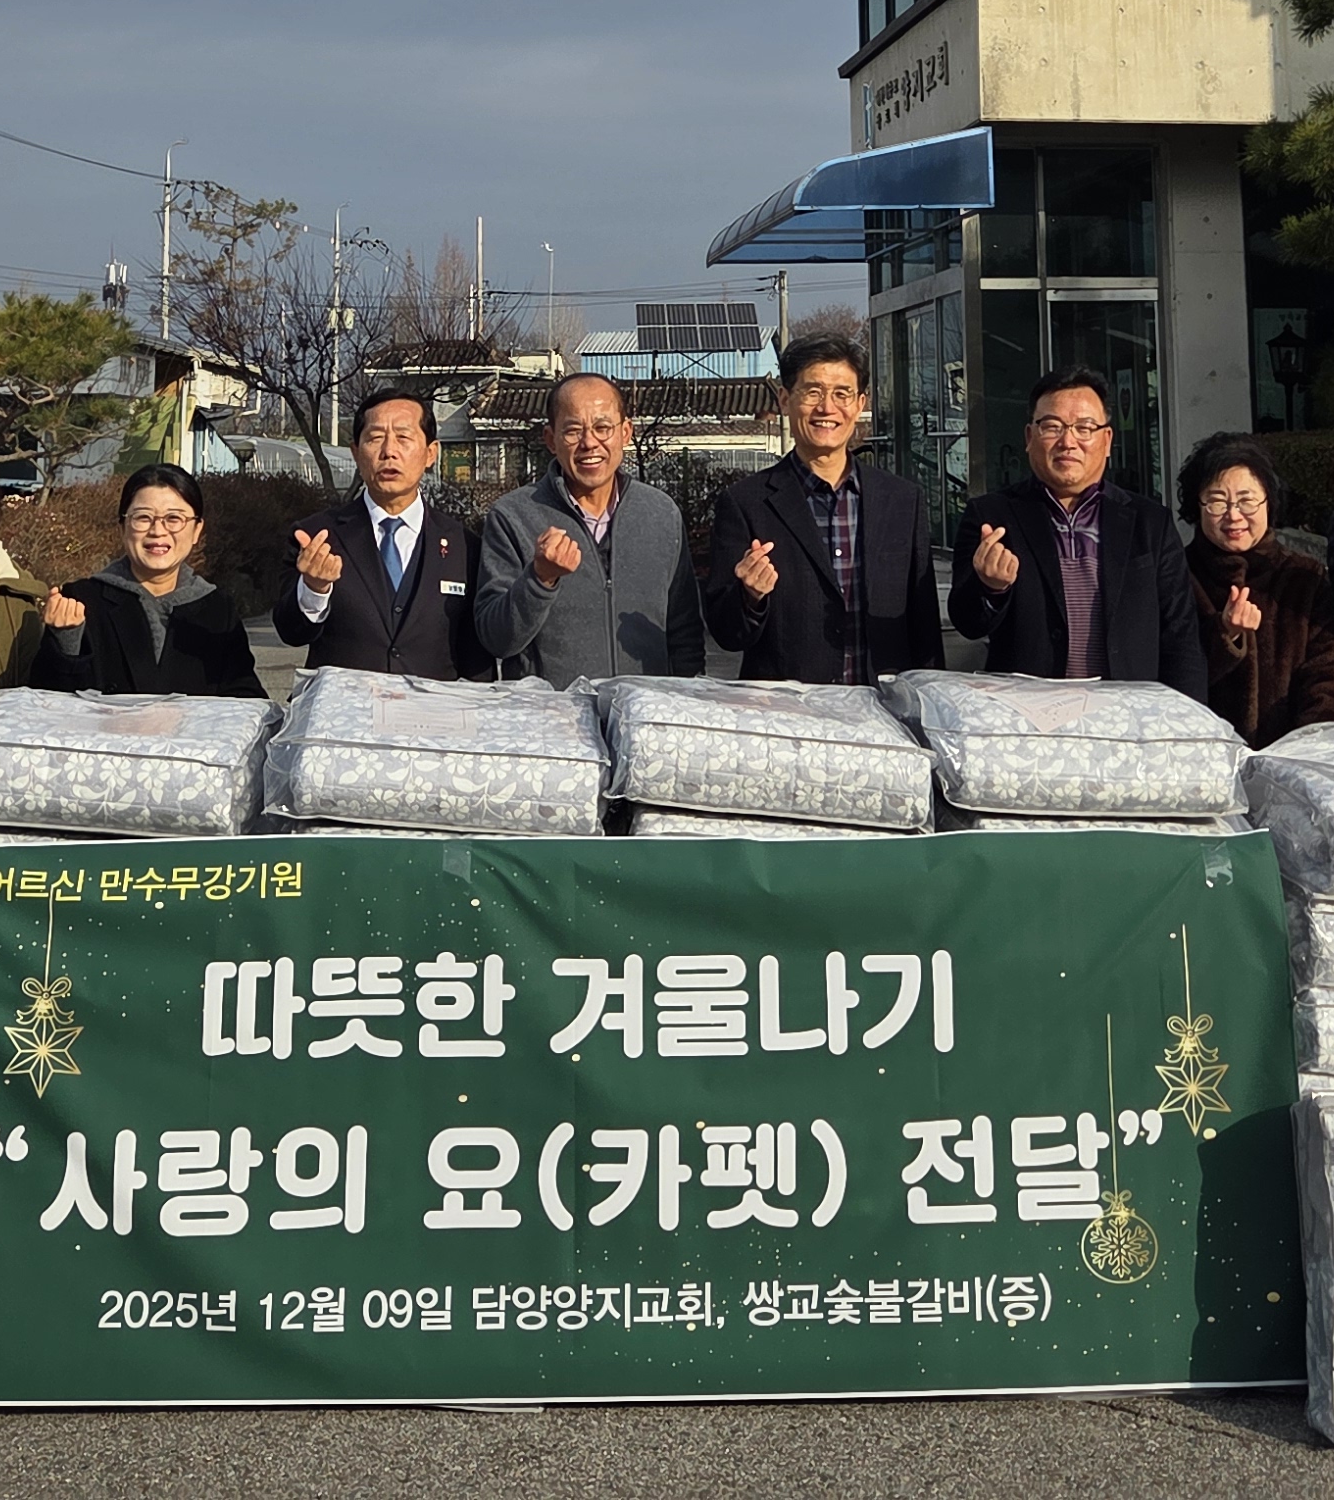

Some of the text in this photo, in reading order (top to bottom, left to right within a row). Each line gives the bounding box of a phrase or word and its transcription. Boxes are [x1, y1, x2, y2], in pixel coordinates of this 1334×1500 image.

[99, 861, 303, 902] 만수무강기원
[201, 948, 955, 1061] 따뜻한 겨울나기
[422, 1117, 848, 1232] 요(카펫)
[97, 1271, 1053, 1334] 2025년 12월 09일 담양양지교회, 쌍교숯불갈비(증)
